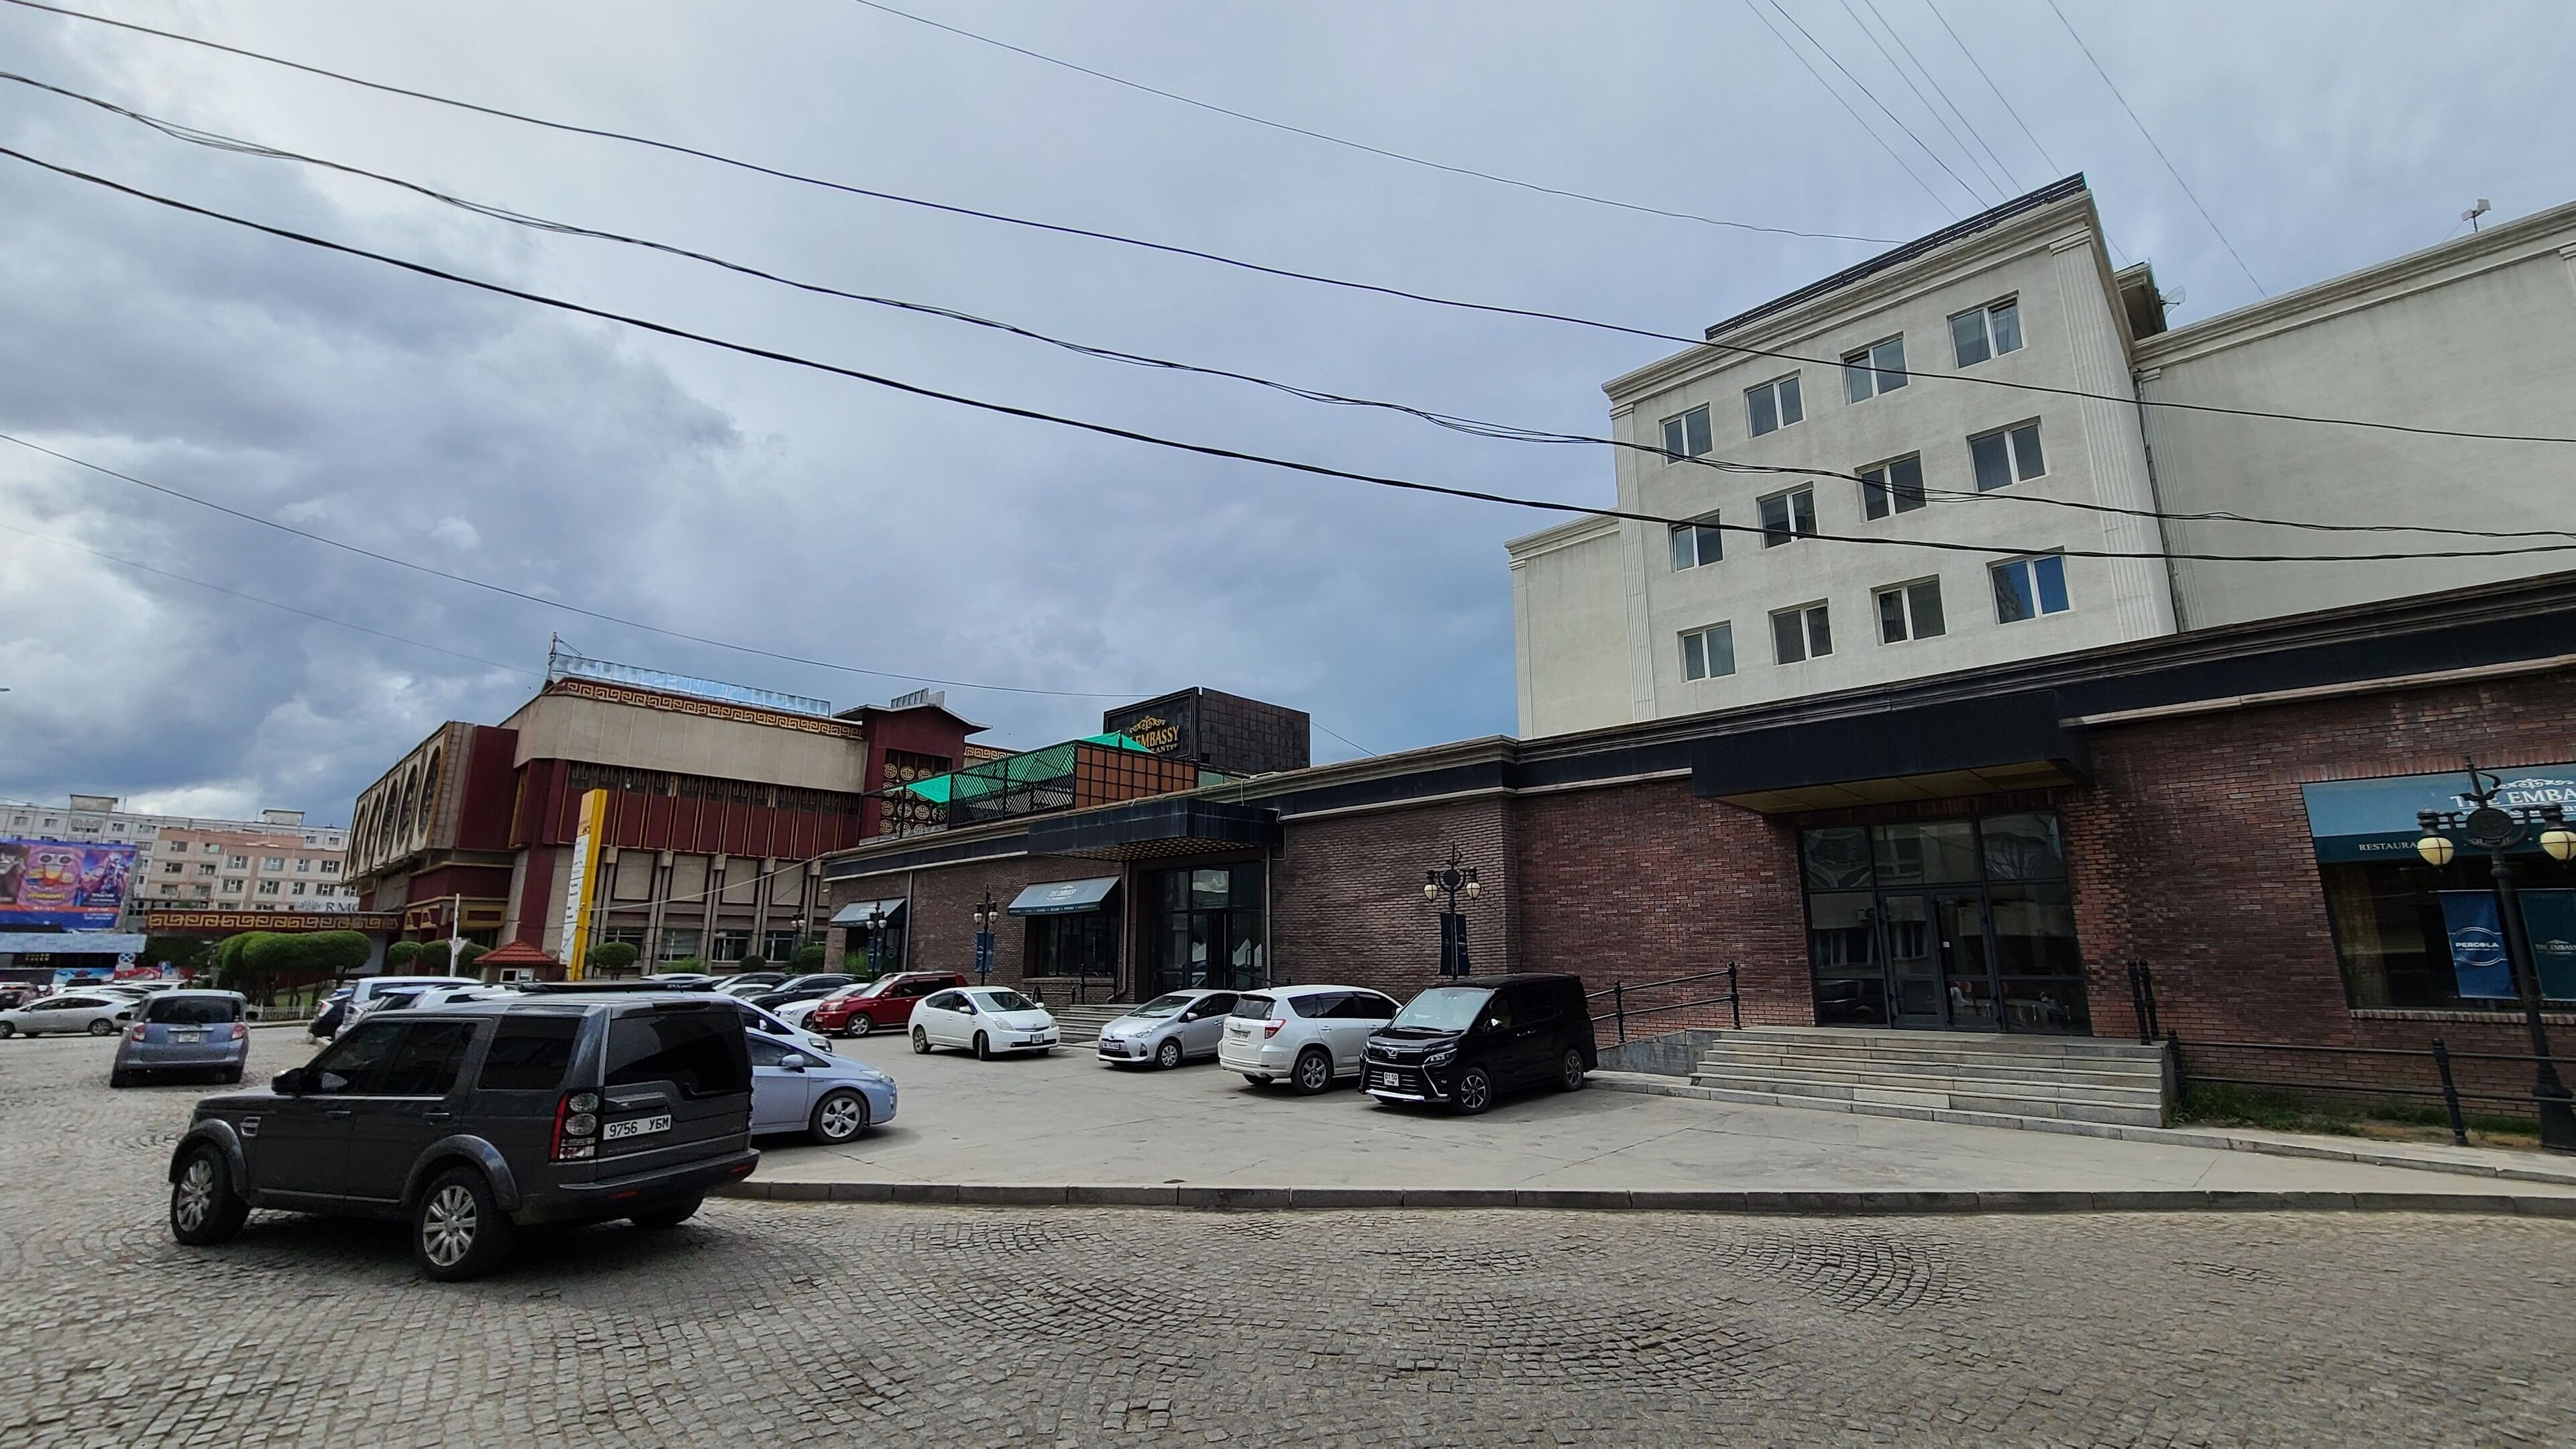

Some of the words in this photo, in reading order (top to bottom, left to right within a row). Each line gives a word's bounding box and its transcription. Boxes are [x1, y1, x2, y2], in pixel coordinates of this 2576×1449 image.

[1136, 725, 1179, 747] EMBASSY
[2359, 841, 2418, 851] RESTAURA
[609, 1122, 638, 1138] 9756
[649, 1116, 669, 1130] УБМ
